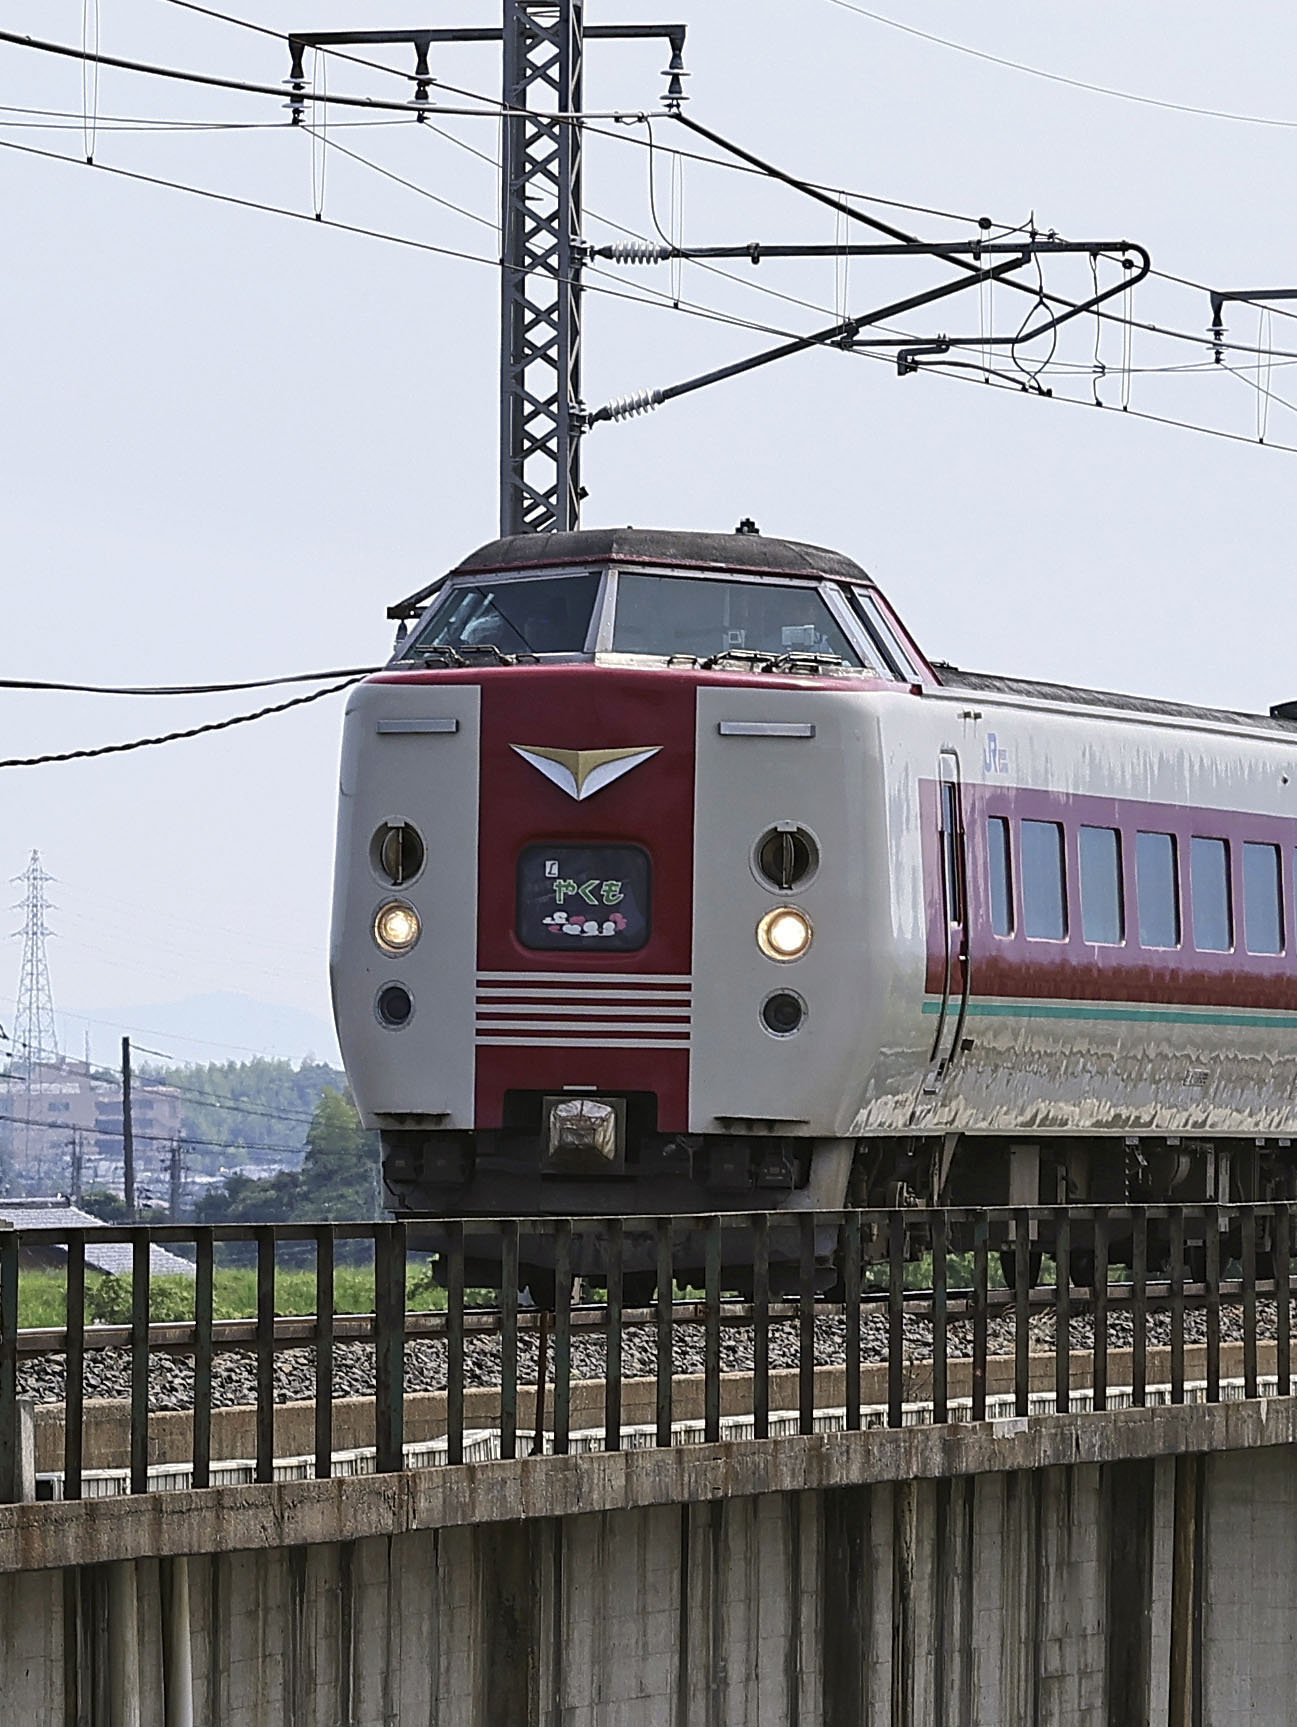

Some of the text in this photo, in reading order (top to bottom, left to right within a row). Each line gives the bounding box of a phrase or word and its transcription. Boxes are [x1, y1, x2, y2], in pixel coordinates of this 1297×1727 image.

[983, 732, 998, 774] JR
[553, 879, 624, 905] やくも
